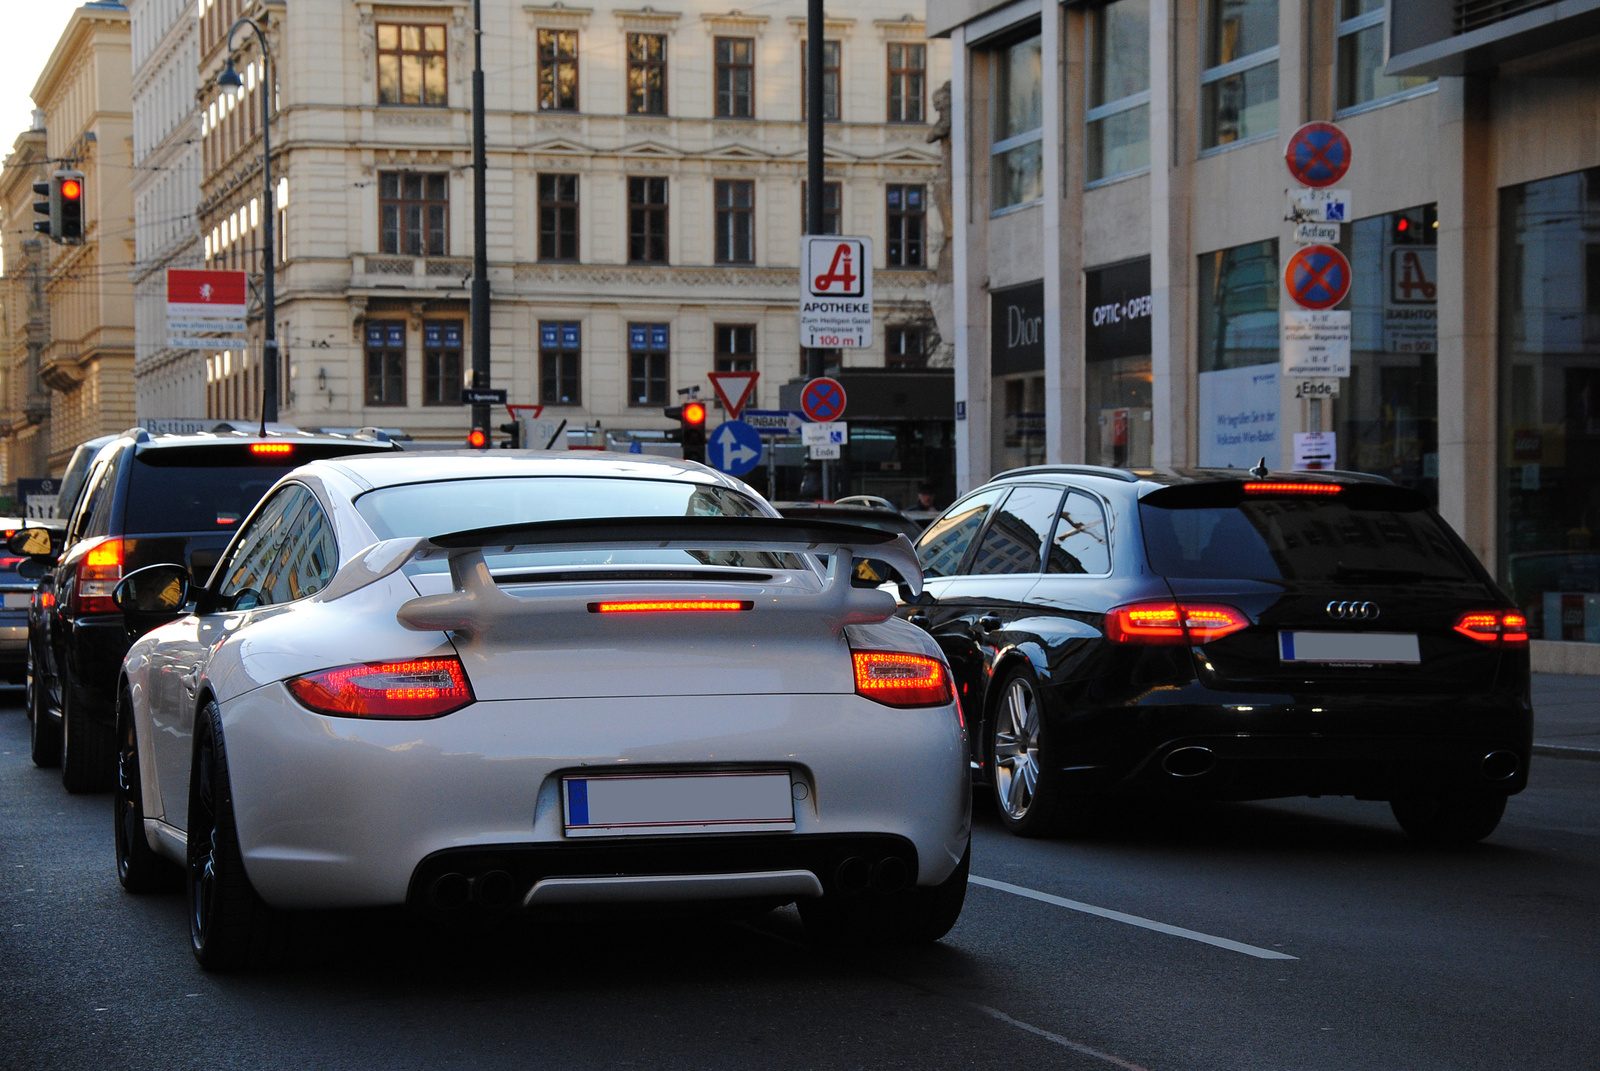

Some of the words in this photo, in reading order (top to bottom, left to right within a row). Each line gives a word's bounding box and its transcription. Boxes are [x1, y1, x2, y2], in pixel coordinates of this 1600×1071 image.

[1301, 225, 1335, 240] Anfang
[803, 303, 870, 313] APOTHEKE
[1093, 303, 1121, 327] OPTIC
[820, 317, 850, 325] Heiligen
[1008, 305, 1042, 348] Dior
[808, 325, 853, 334] Operngasse
[820, 336, 840, 345] 100
[843, 338, 854, 346] m
[1303, 381, 1332, 394] Ende
[147, 418, 204, 434] Bettina
[746, 416, 787, 427] EINBAHN
[815, 448, 835, 457] Ende
